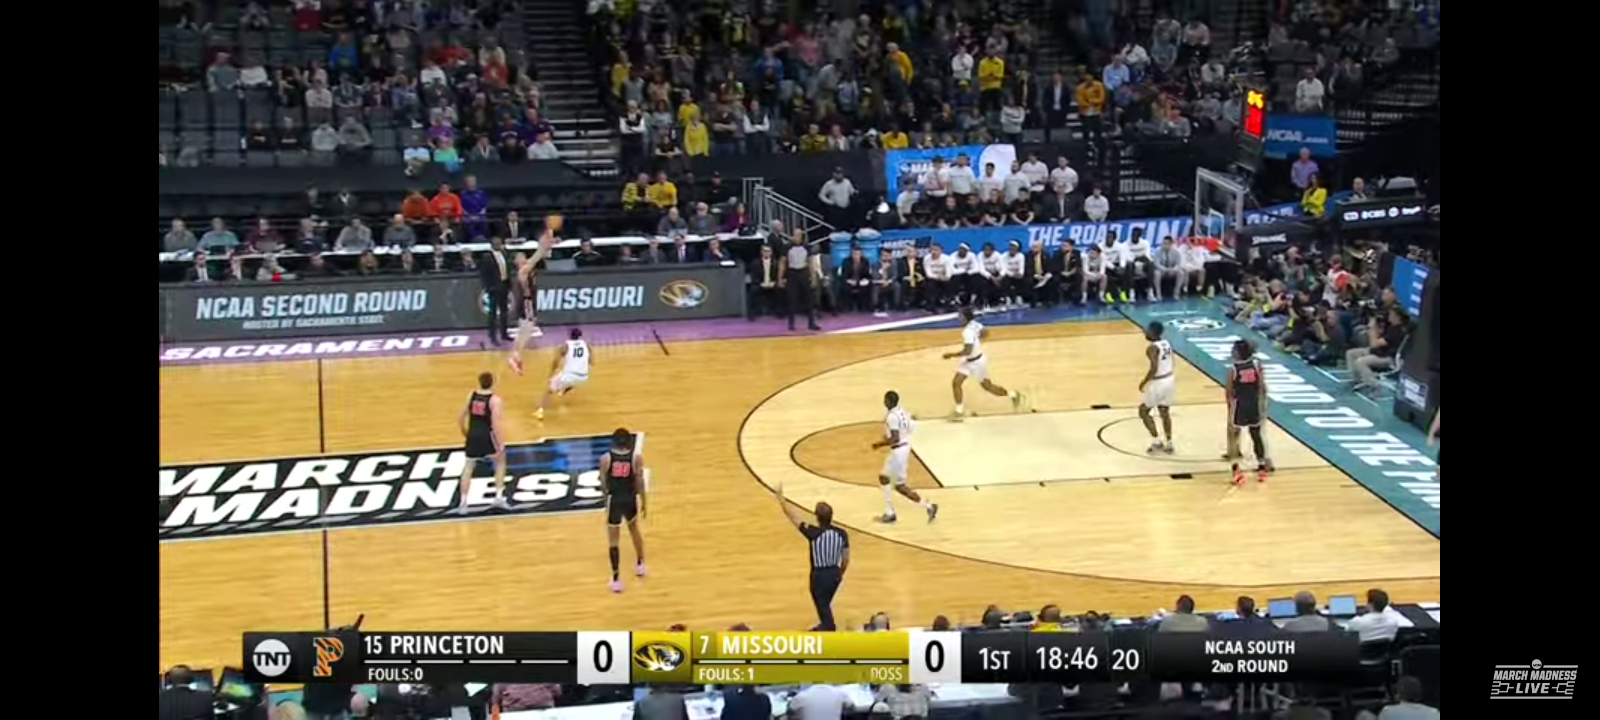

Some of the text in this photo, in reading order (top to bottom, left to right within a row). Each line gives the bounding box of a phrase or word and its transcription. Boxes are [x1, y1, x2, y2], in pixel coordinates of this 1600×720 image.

[1027, 226, 1064, 246] THE
[196, 290, 427, 320] NCAA SECOND ROUND
[536, 285, 645, 310] MISSOURI
[160, 335, 469, 361] SACRAMENTO
[572, 347, 585, 358] 10
[1291, 406, 1374, 429] TO
[1328, 431, 1437, 467] THE
[159, 451, 466, 496] MARCH
